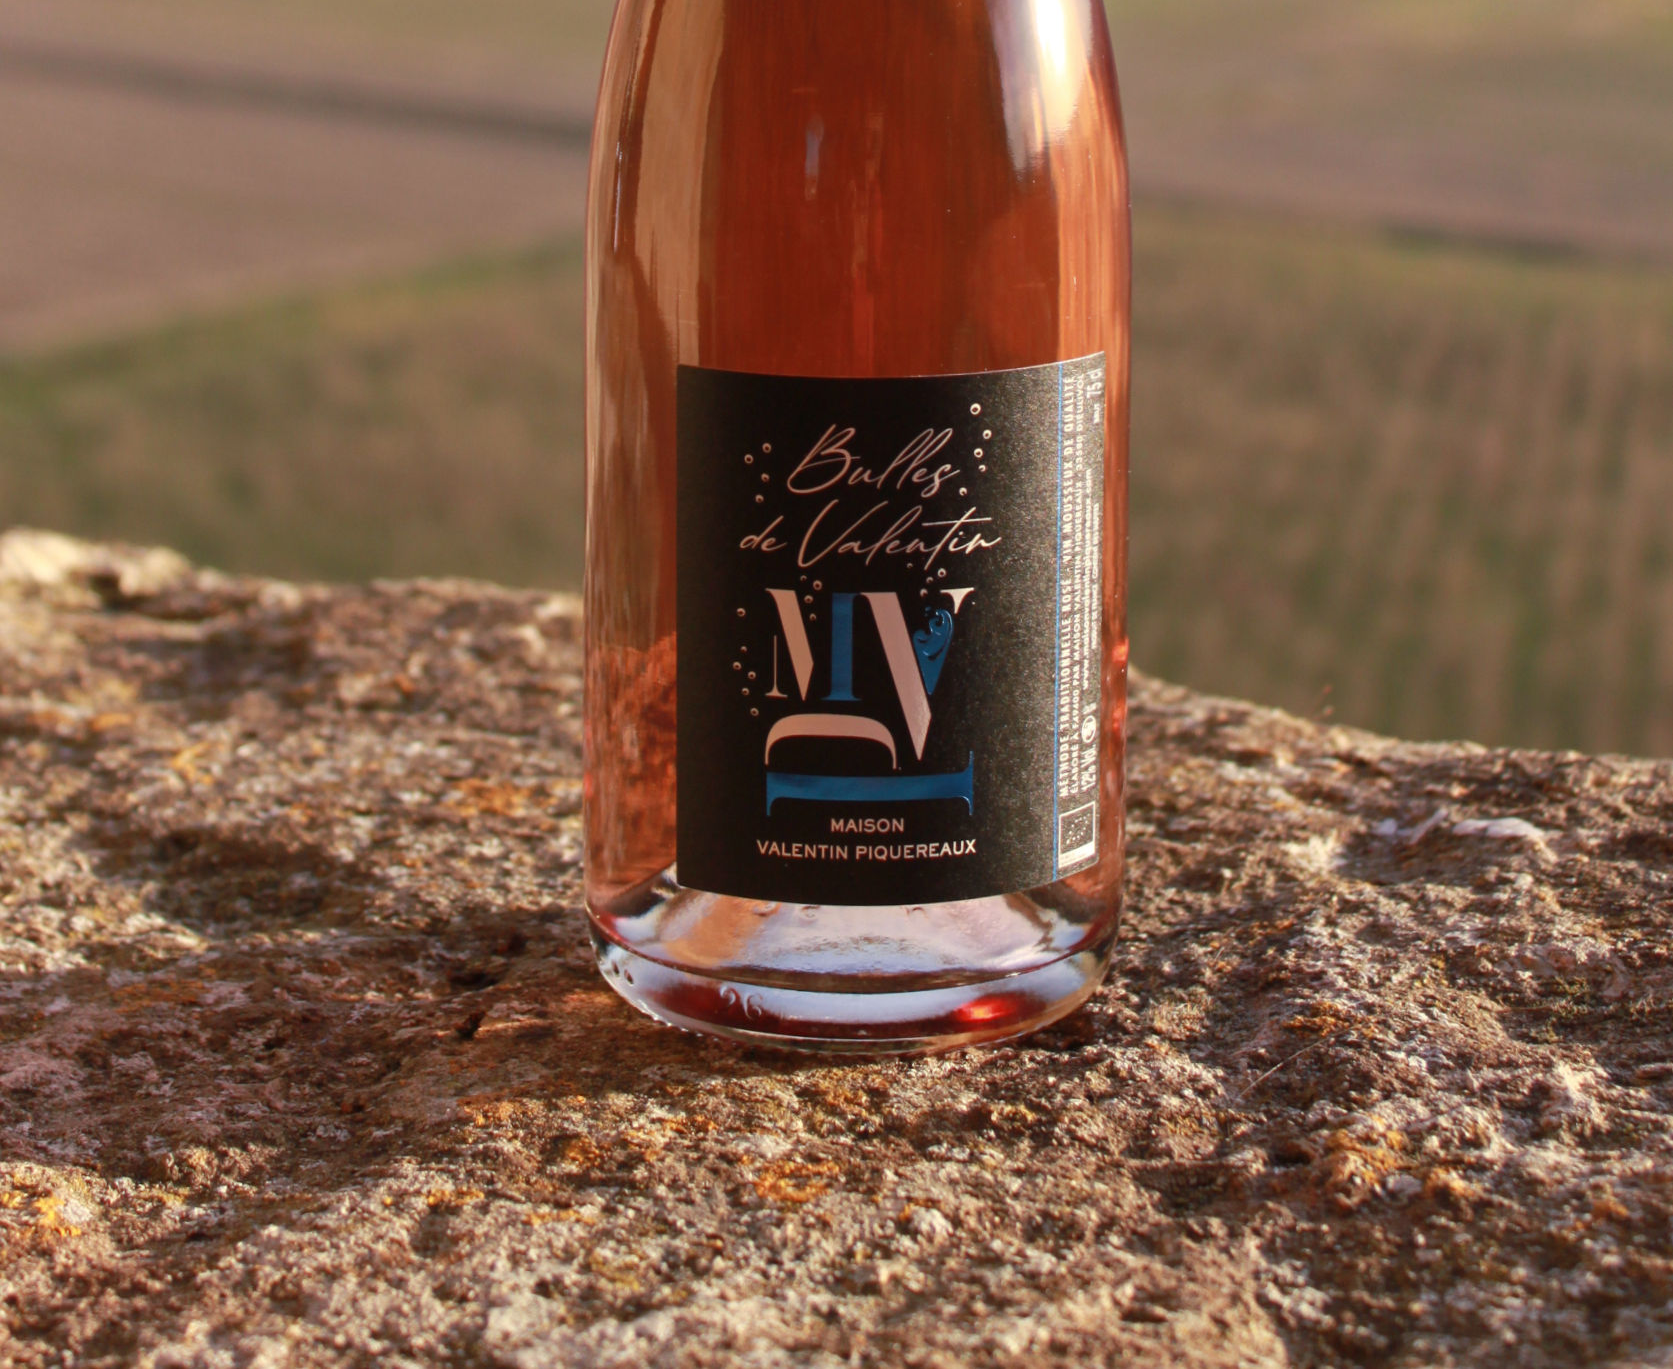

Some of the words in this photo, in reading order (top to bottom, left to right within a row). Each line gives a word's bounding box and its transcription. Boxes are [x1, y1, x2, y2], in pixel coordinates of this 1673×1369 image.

[1063, 376, 1074, 432] QUALITÉ
[1086, 381, 1102, 399] 75
[787, 424, 960, 498] Bulles
[1063, 438, 1074, 456] DE
[1062, 461, 1073, 534] MOUSSEUX
[1075, 481, 1083, 552] PIQUEREAUX
[739, 515, 787, 552] de
[797, 499, 1002, 570] Valentin
[1062, 539, 1073, 564] VIN
[1074, 554, 1082, 611] VALENTIN
[1073, 613, 1081, 661] MAISON
[1060, 617, 1071, 731] TRADITIONNELLE
[756, 839, 849, 860] VALENTIN
[855, 838, 977, 861] PIQUEREAUX
[830, 818, 905, 833] MAISON
